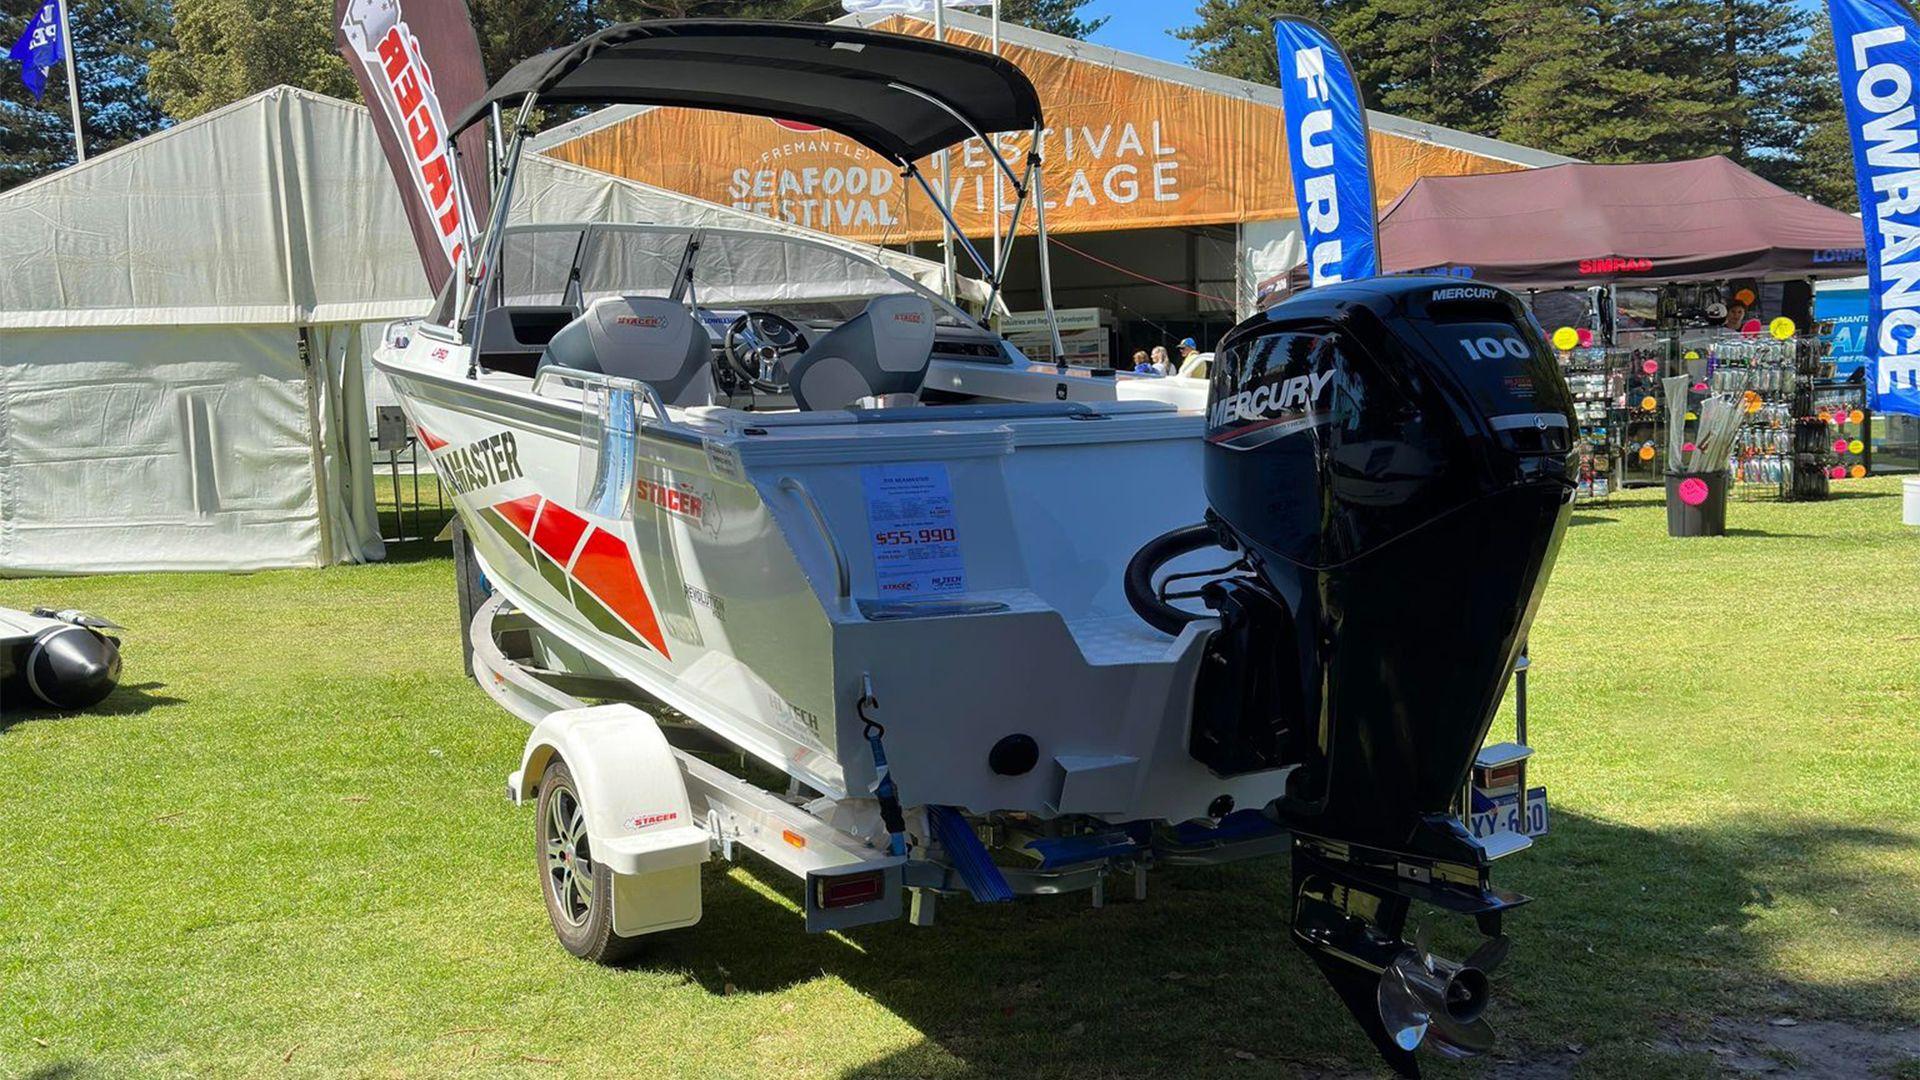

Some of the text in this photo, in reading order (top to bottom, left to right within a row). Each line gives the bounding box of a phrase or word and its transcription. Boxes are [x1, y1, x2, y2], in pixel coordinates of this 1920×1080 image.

[761, 141, 865, 163] FREMANTLE
[729, 166, 894, 198] SEAFOOD
[932, 162, 1180, 214] VILLAGE
[1851, 25, 1920, 395] LOWRANCE
[1578, 256, 1654, 275] SIMRAD
[1432, 287, 1499, 301] MERCURY
[1459, 337, 1530, 361] 100
[1209, 369, 1337, 429] MERCURY
[637, 477, 703, 518] STACER
[634, 812, 677, 826] STACER
